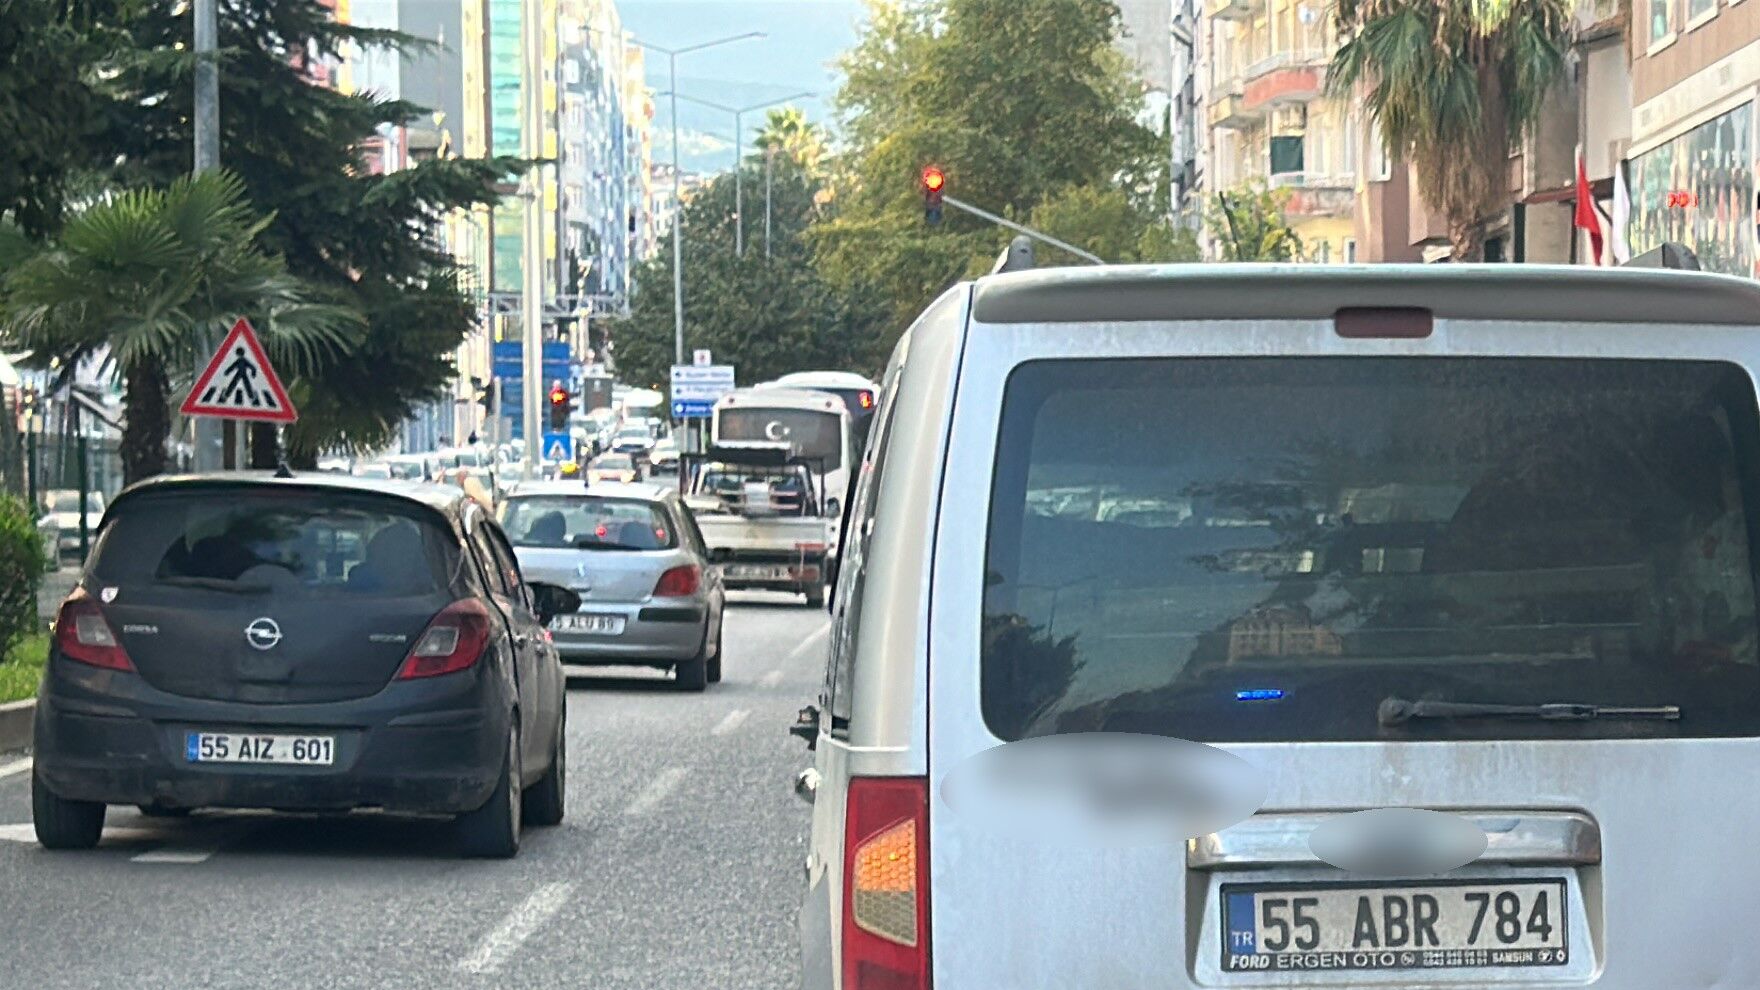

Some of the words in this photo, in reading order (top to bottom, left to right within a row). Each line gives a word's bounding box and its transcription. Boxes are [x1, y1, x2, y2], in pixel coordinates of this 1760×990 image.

[200, 737, 229, 759] 55
[238, 737, 274, 760] AIZ
[292, 739, 331, 761] 601
[1262, 896, 1321, 951] 55
[1352, 893, 1440, 948] ABR
[1463, 890, 1552, 945] 784
[1231, 931, 1254, 946] TR
[1229, 954, 1270, 969] FORD
[1276, 953, 1347, 968] ERGEN
[1353, 952, 1396, 968] OTO
